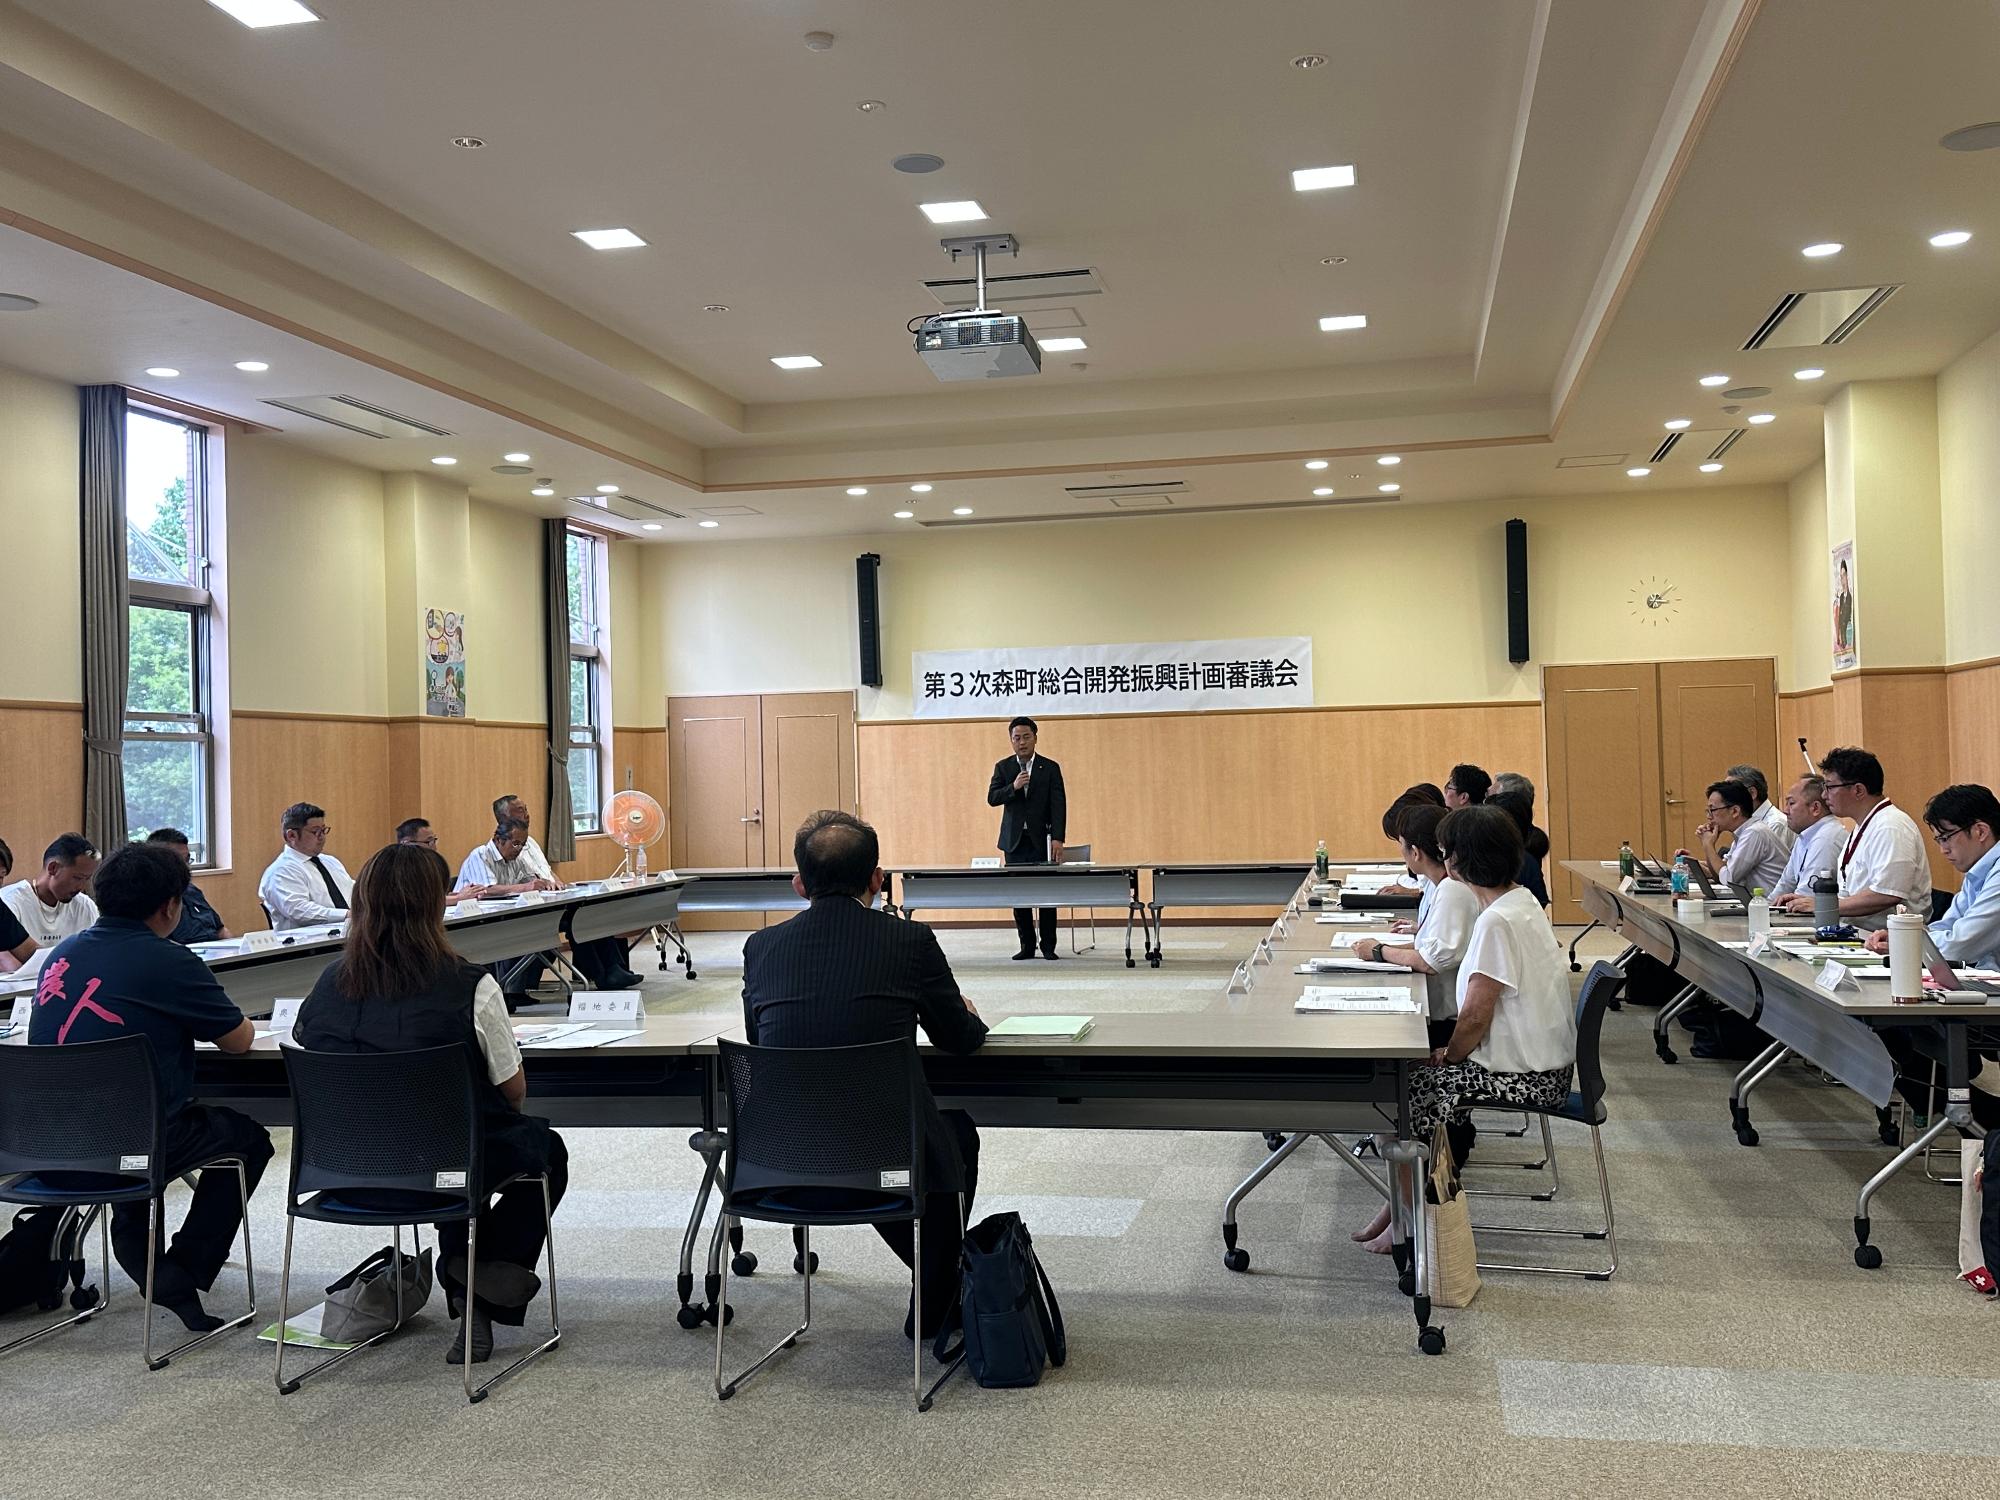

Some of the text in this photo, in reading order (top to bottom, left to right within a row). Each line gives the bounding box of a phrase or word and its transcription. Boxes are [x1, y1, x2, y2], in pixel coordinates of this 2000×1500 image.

[924, 658, 1299, 699] 第3次森町総合開発振興計画審議会
